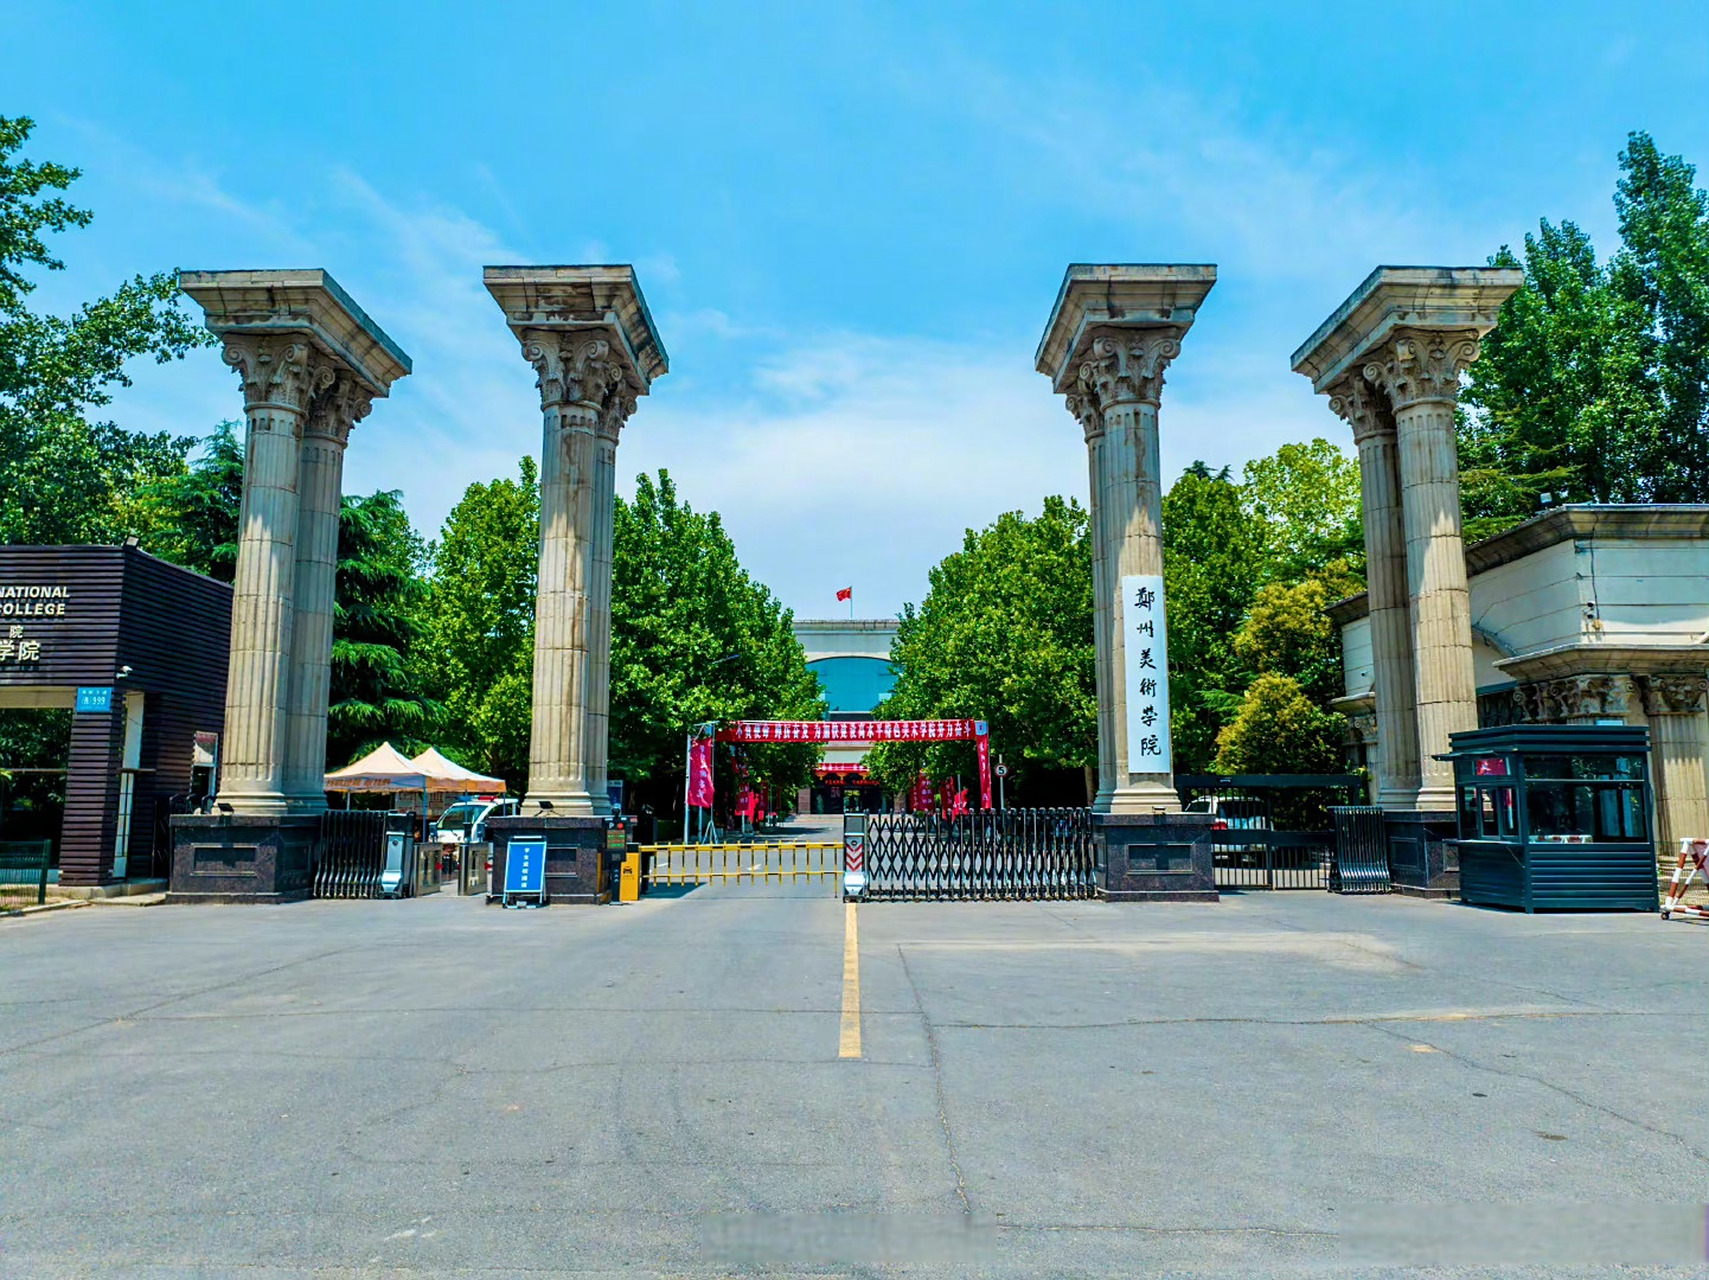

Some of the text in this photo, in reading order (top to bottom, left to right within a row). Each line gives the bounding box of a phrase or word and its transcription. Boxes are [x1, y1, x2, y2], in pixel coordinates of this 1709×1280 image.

[0, 603, 65, 615] OLLEGE
[0, 640, 40, 661] 学院
[998, 766, 1005, 775] 5
